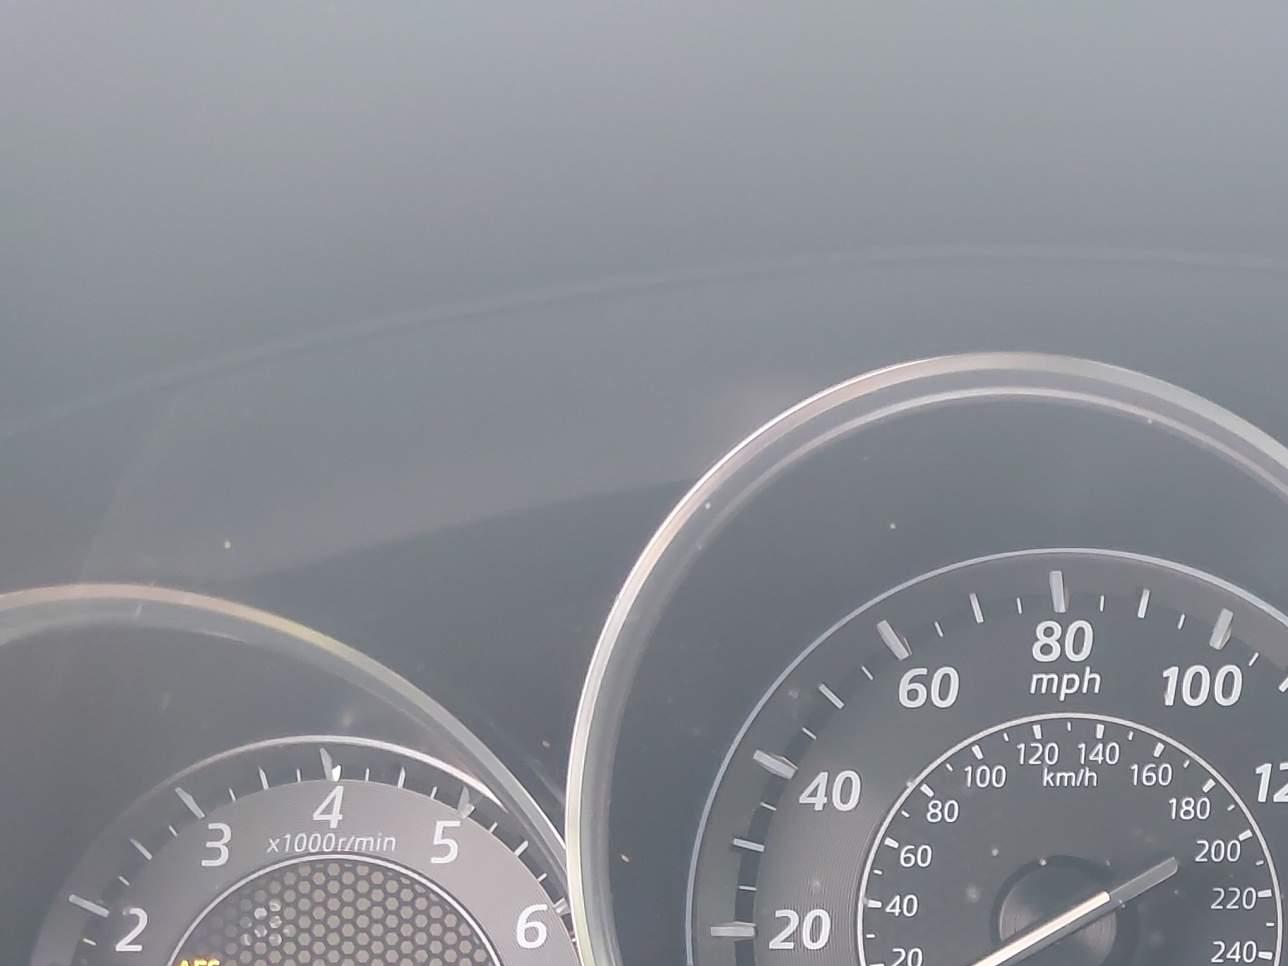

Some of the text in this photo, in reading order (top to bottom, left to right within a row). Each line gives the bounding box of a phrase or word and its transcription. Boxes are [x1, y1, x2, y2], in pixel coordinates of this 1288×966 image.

[1032, 620, 1093, 662] 80
[898, 666, 959, 708] 60
[1030, 666, 1101, 702] mph
[1162, 664, 1243, 707] 100
[1016, 742, 1059, 765] 120
[1077, 742, 1120, 765] 140
[964, 764, 1006, 788] 100
[1042, 766, 1097, 787] km/h
[1130, 763, 1172, 786] 160
[798, 770, 861, 812] 40
[312, 785, 344, 829] 4
[926, 799, 959, 823] 80
[1168, 797, 1211, 820] 180
[201, 822, 232, 867] 3
[266, 832, 398, 854] x1000r/min
[430, 819, 462, 864] 5
[1194, 840, 1241, 863] 200
[898, 844, 933, 868] 60
[885, 894, 918, 917] 40
[1210, 887, 1257, 910] 220
[115, 909, 148, 952] 2
[516, 903, 548, 949] 6
[768, 908, 831, 950] 20
[1211, 940, 1257, 963] 240
